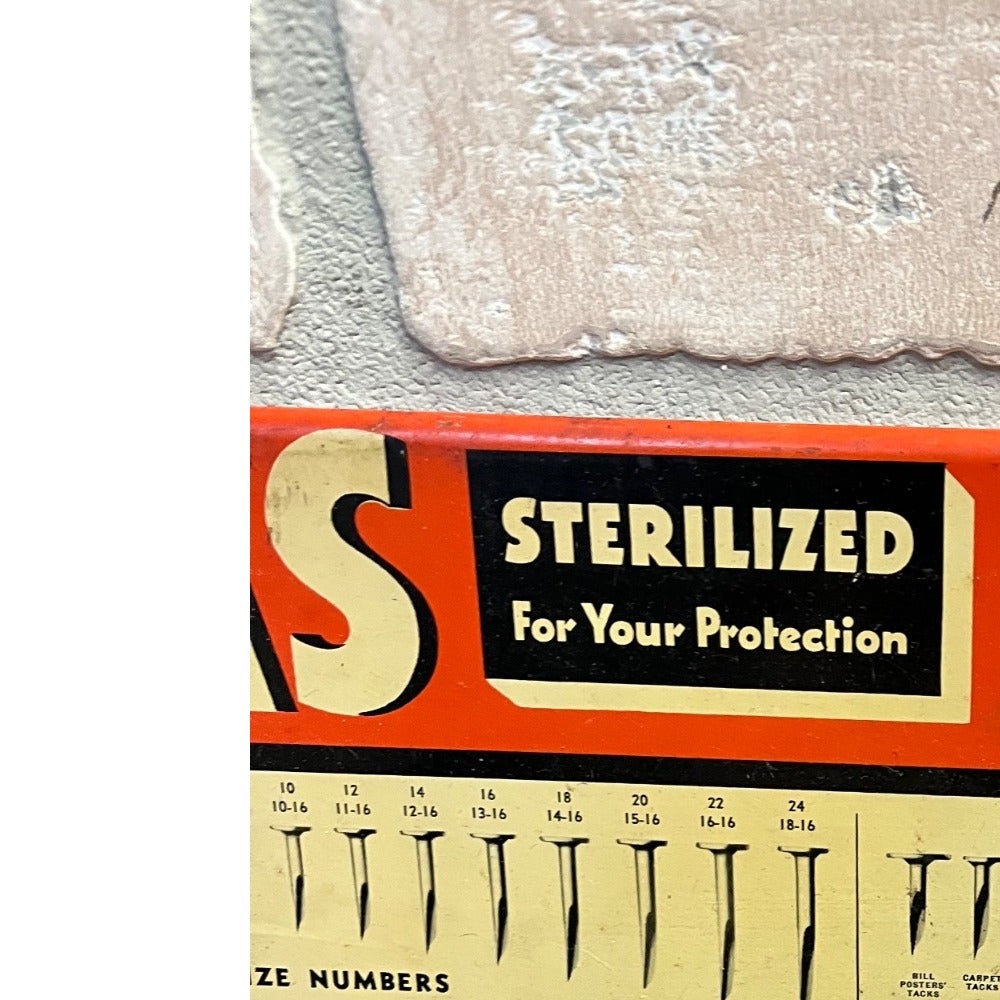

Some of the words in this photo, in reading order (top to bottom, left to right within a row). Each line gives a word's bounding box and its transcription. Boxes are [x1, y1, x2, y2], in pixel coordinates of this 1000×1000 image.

[501, 496, 914, 575] STERILIZED
[511, 600, 577, 642] For
[581, 602, 686, 646] Your
[695, 605, 908, 655] Protection
[280, 782, 295, 794] 10
[344, 784, 359, 796] 12
[410, 786, 425, 798] 14
[481, 788, 496, 800] 16
[557, 791, 571, 803] 18
[632, 794, 648, 806] 20
[707, 797, 724, 809] 22
[272, 801, 308, 813] 10-16
[336, 803, 371, 815] 11-16
[403, 805, 438, 817] 12-16
[788, 800, 805, 812] 24
[472, 807, 507, 820] 13-16
[547, 810, 583, 822] 14-16
[625, 812, 660, 825] 15-16
[700, 815, 736, 828] 16-16
[780, 818, 816, 831] 18-16
[309, 969, 450, 993] NUMBERS
[912, 972, 935, 981] BILL
[966, 983, 999, 991] TACKS
[907, 989, 940, 998] TACKS
